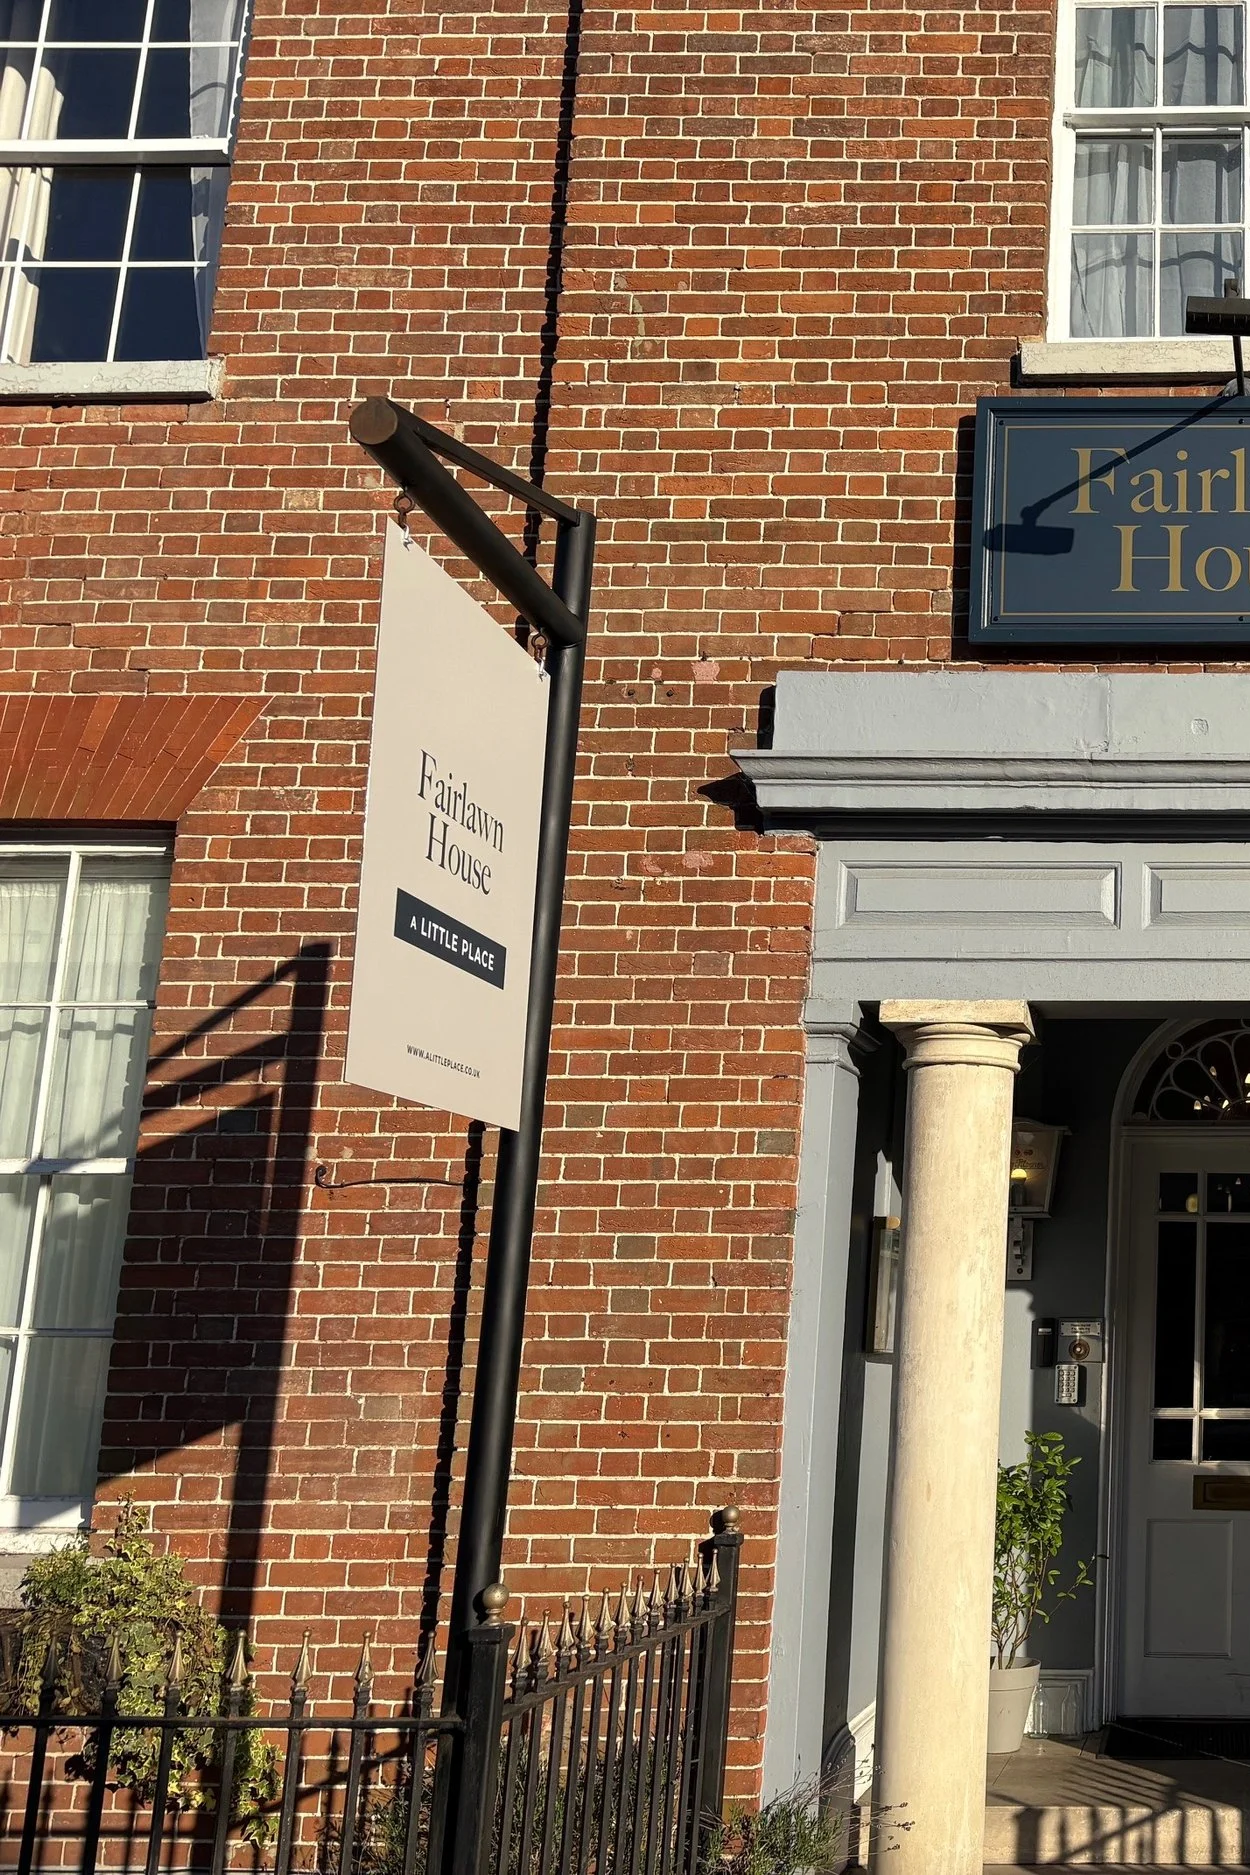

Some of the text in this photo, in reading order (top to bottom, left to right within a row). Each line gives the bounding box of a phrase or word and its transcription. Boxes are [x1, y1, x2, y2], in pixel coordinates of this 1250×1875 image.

[417, 748, 504, 853] Fairlawn
[425, 811, 492, 895] House
[410, 915, 495, 971] A LITTLE PLACE
[406, 1044, 481, 1079] WWW.ALITTLEPLACE.CO.UK
